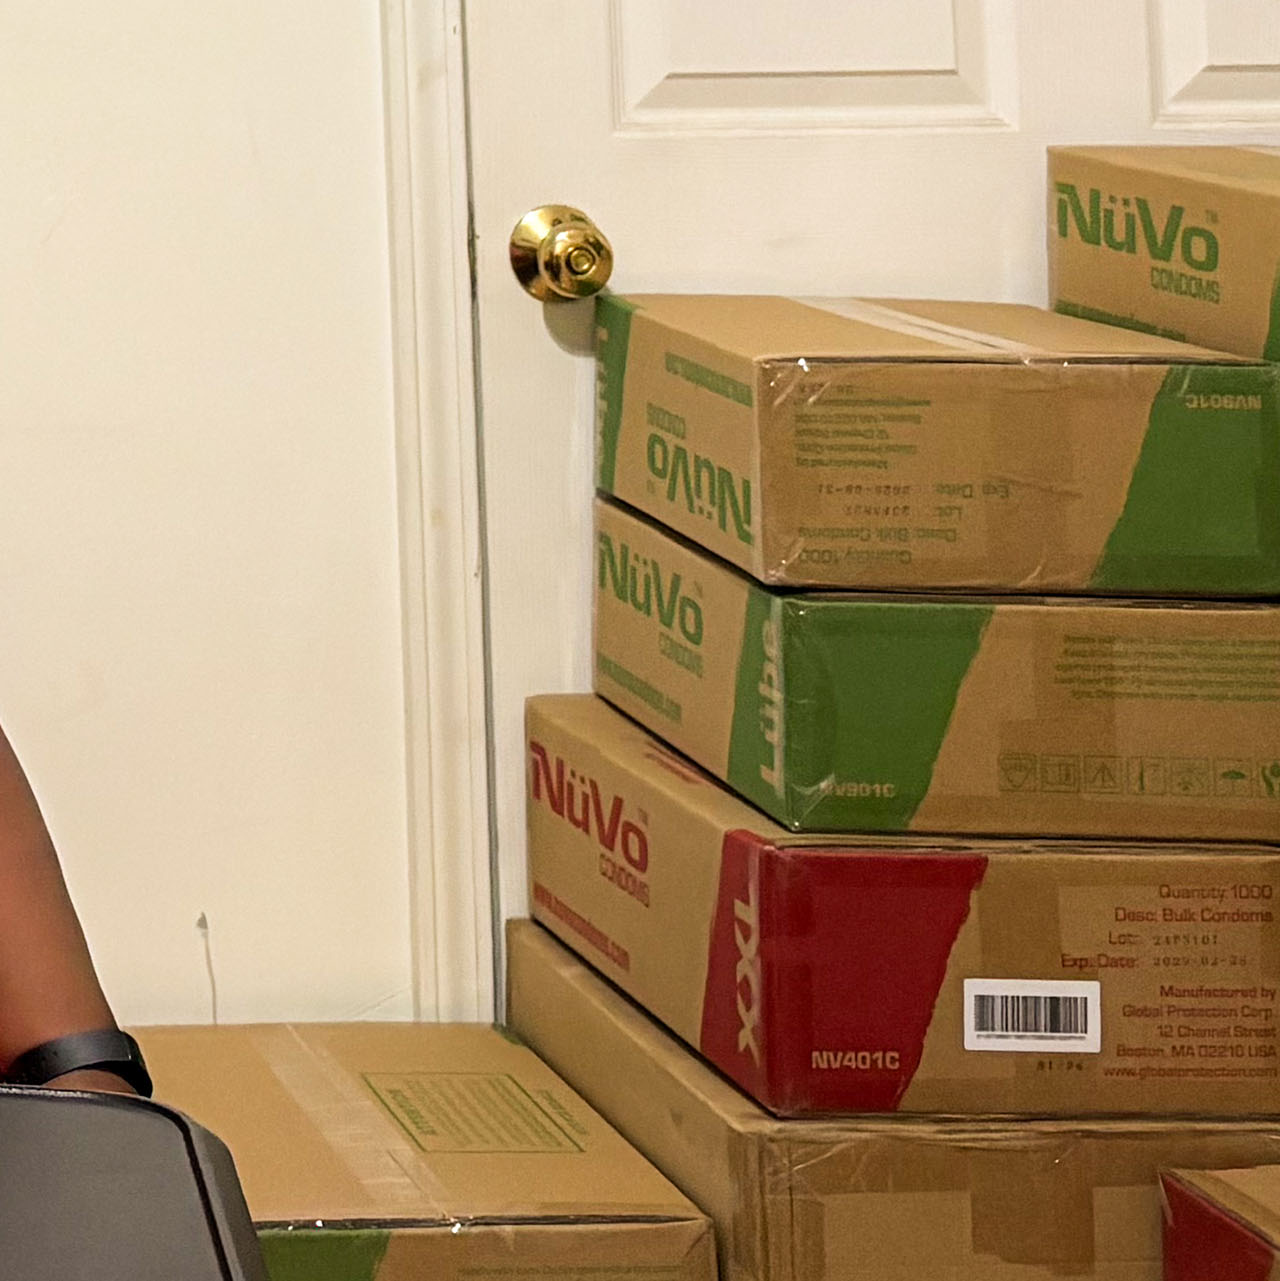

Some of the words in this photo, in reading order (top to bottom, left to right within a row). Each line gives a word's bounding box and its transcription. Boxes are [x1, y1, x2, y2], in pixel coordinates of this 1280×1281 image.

[1054, 182, 1219, 272] NüVo
[1150, 266, 1220, 305] CONDOMS
[646, 433, 753, 545] NüVo
[598, 530, 704, 647] NüVo
[530, 740, 649, 874] NüVo
[1162, 906, 1196, 922] Bulk
[1200, 906, 1273, 922] Condoms
[1160, 985, 1258, 999] Manufactured
[1261, 985, 1277, 1001] by
[1122, 1005, 1163, 1019] Global
[1168, 1005, 1237, 1019] Protection
[1157, 1025, 1173, 1038] 12
[1177, 1025, 1231, 1038] Channel
[1234, 1025, 1278, 1038] Street
[812, 1051, 900, 1070] NV401C
[1172, 1044, 1195, 1058] MA
[1198, 1044, 1244, 1058] 02210
[1247, 1044, 1278, 1058] USA
